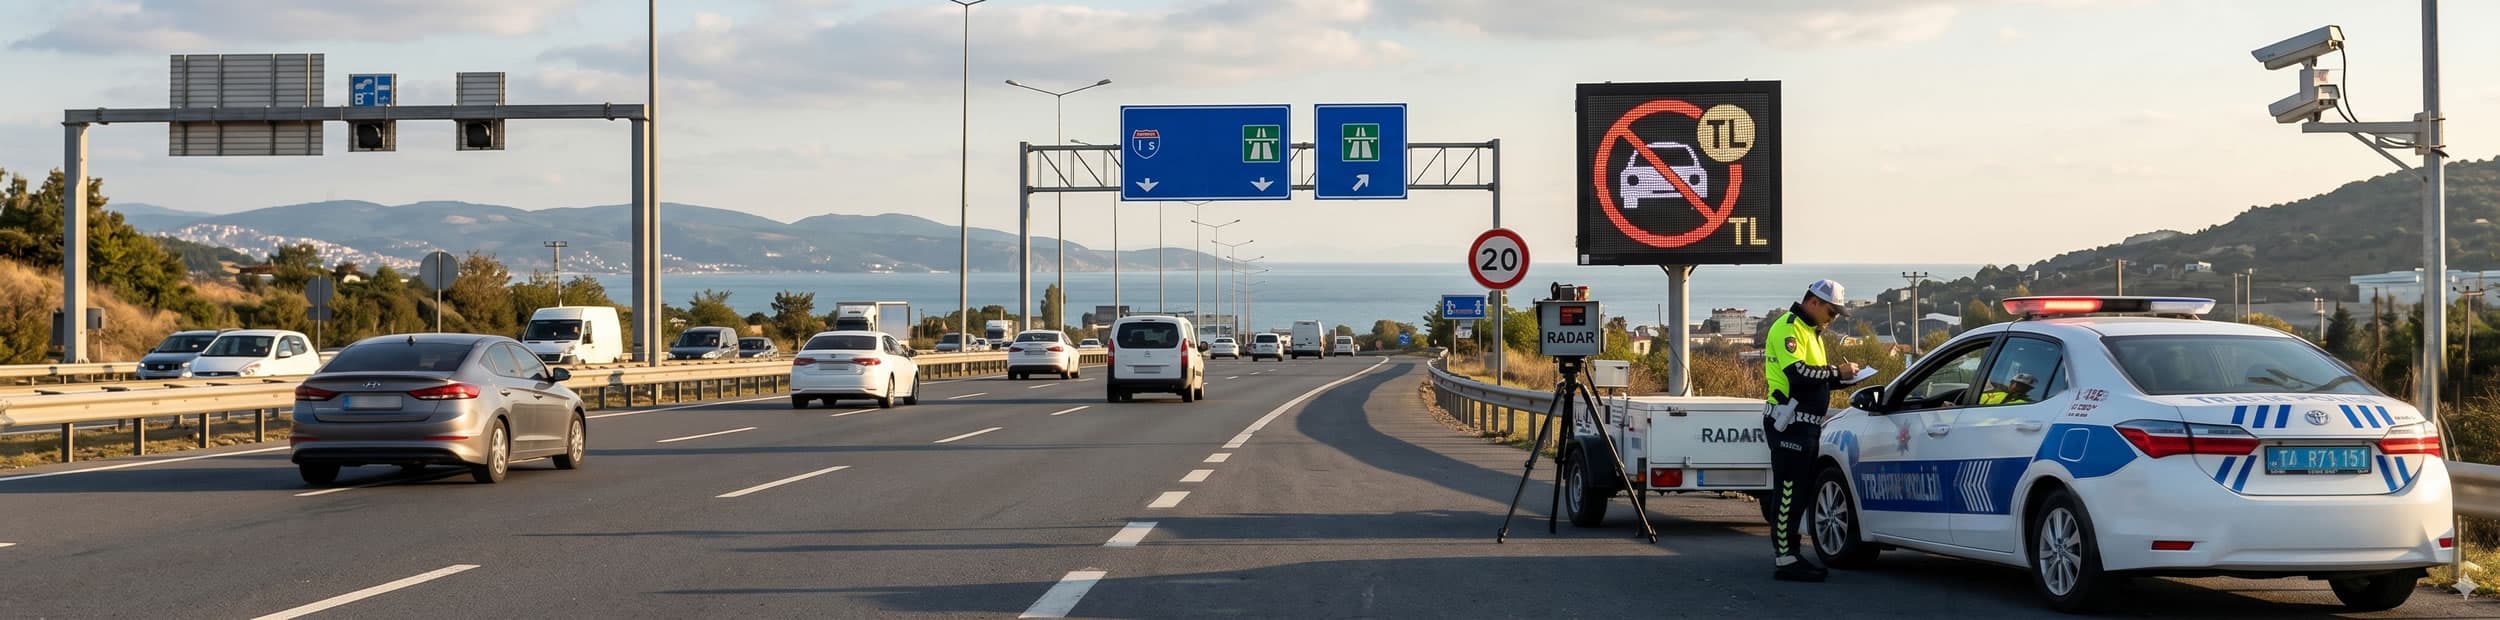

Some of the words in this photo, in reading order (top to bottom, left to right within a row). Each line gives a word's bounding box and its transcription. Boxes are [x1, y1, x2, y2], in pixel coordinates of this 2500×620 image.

[1706, 119, 1746, 149] TL
[1728, 217, 1768, 246] TL
[1481, 247, 1517, 272] 20
[1547, 331, 1595, 344] RADAR
[1702, 428, 1765, 443] RADAR
[2343, 449, 2366, 468] 151
